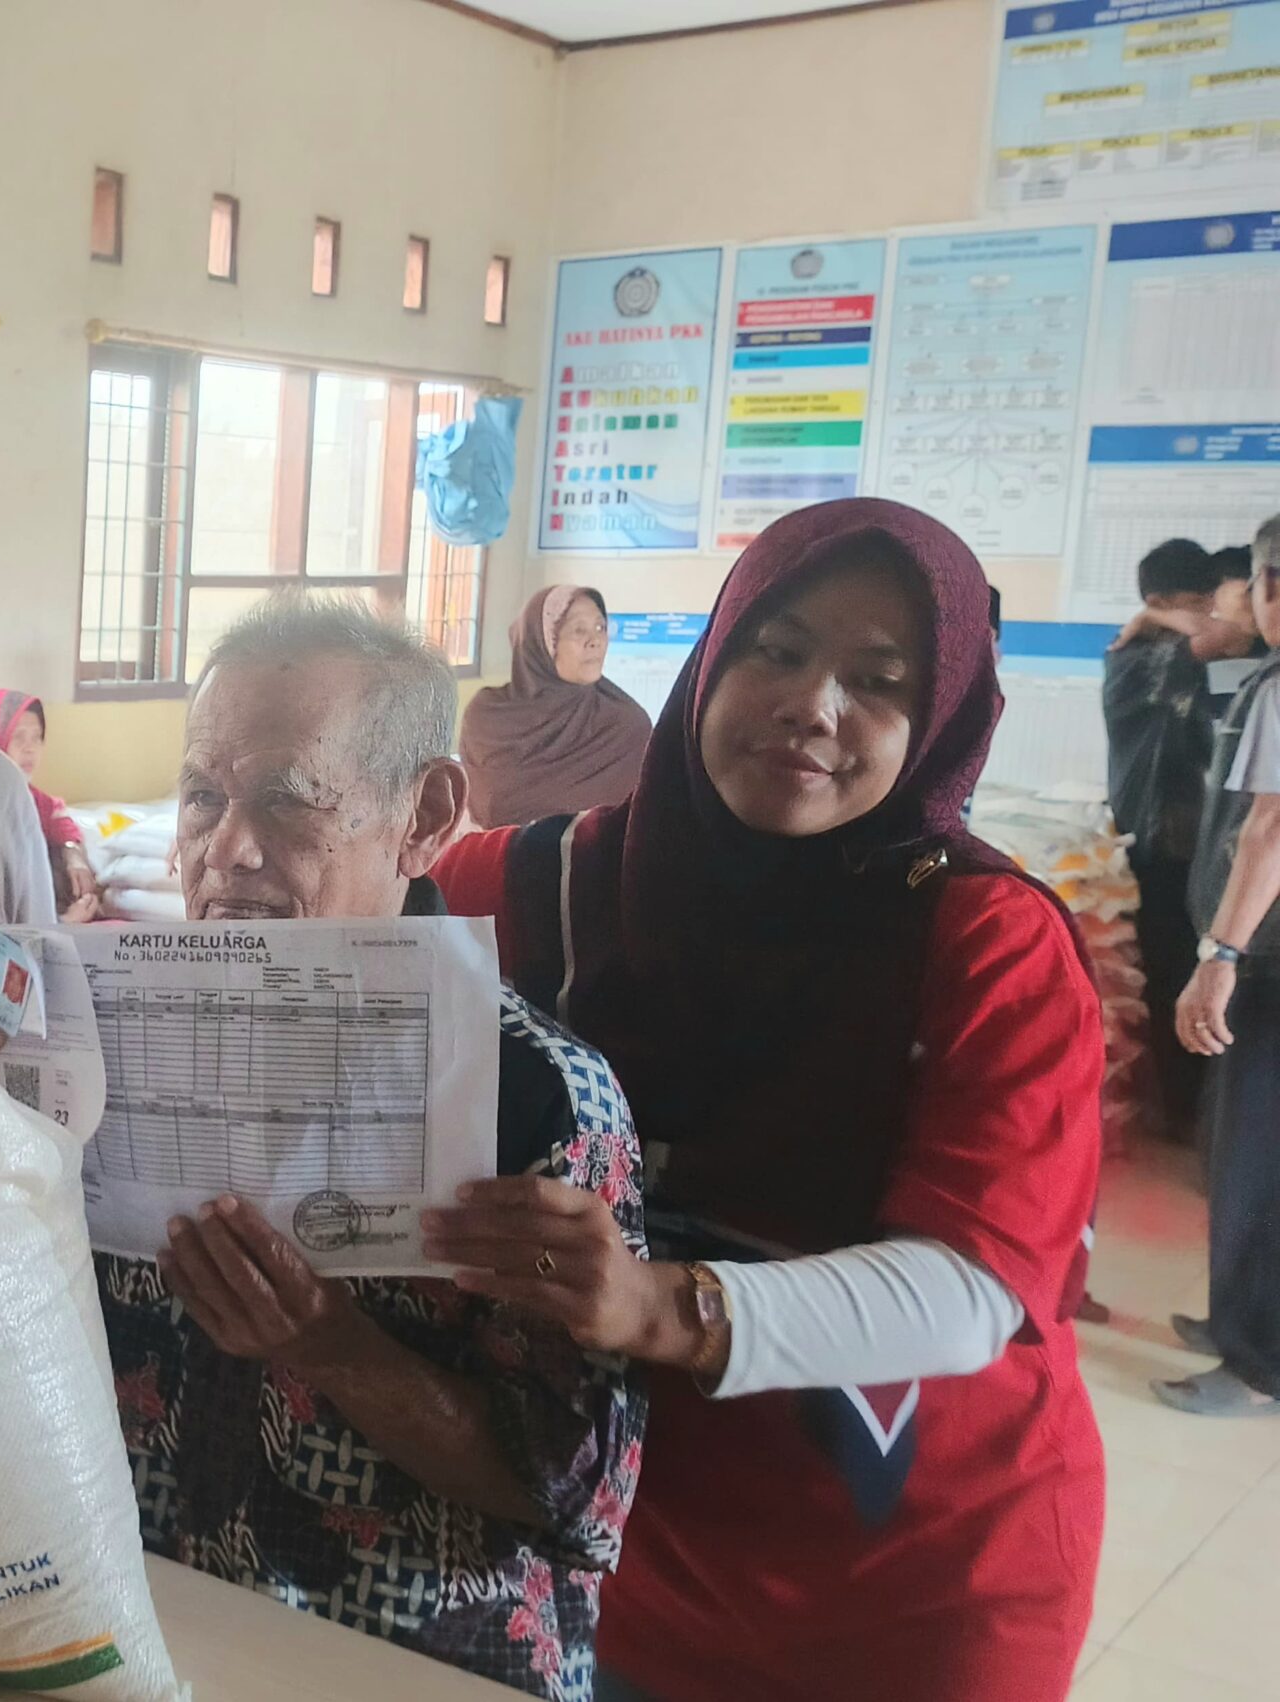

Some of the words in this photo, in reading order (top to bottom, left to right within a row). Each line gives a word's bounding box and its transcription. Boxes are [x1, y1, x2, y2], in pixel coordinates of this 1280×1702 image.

[555, 440, 609, 458] Asri
[551, 488, 629, 507] Indah
[119, 933, 173, 948] KARTU
[177, 934, 268, 950] KELUARGA
[54, 1109, 69, 1125] 23
